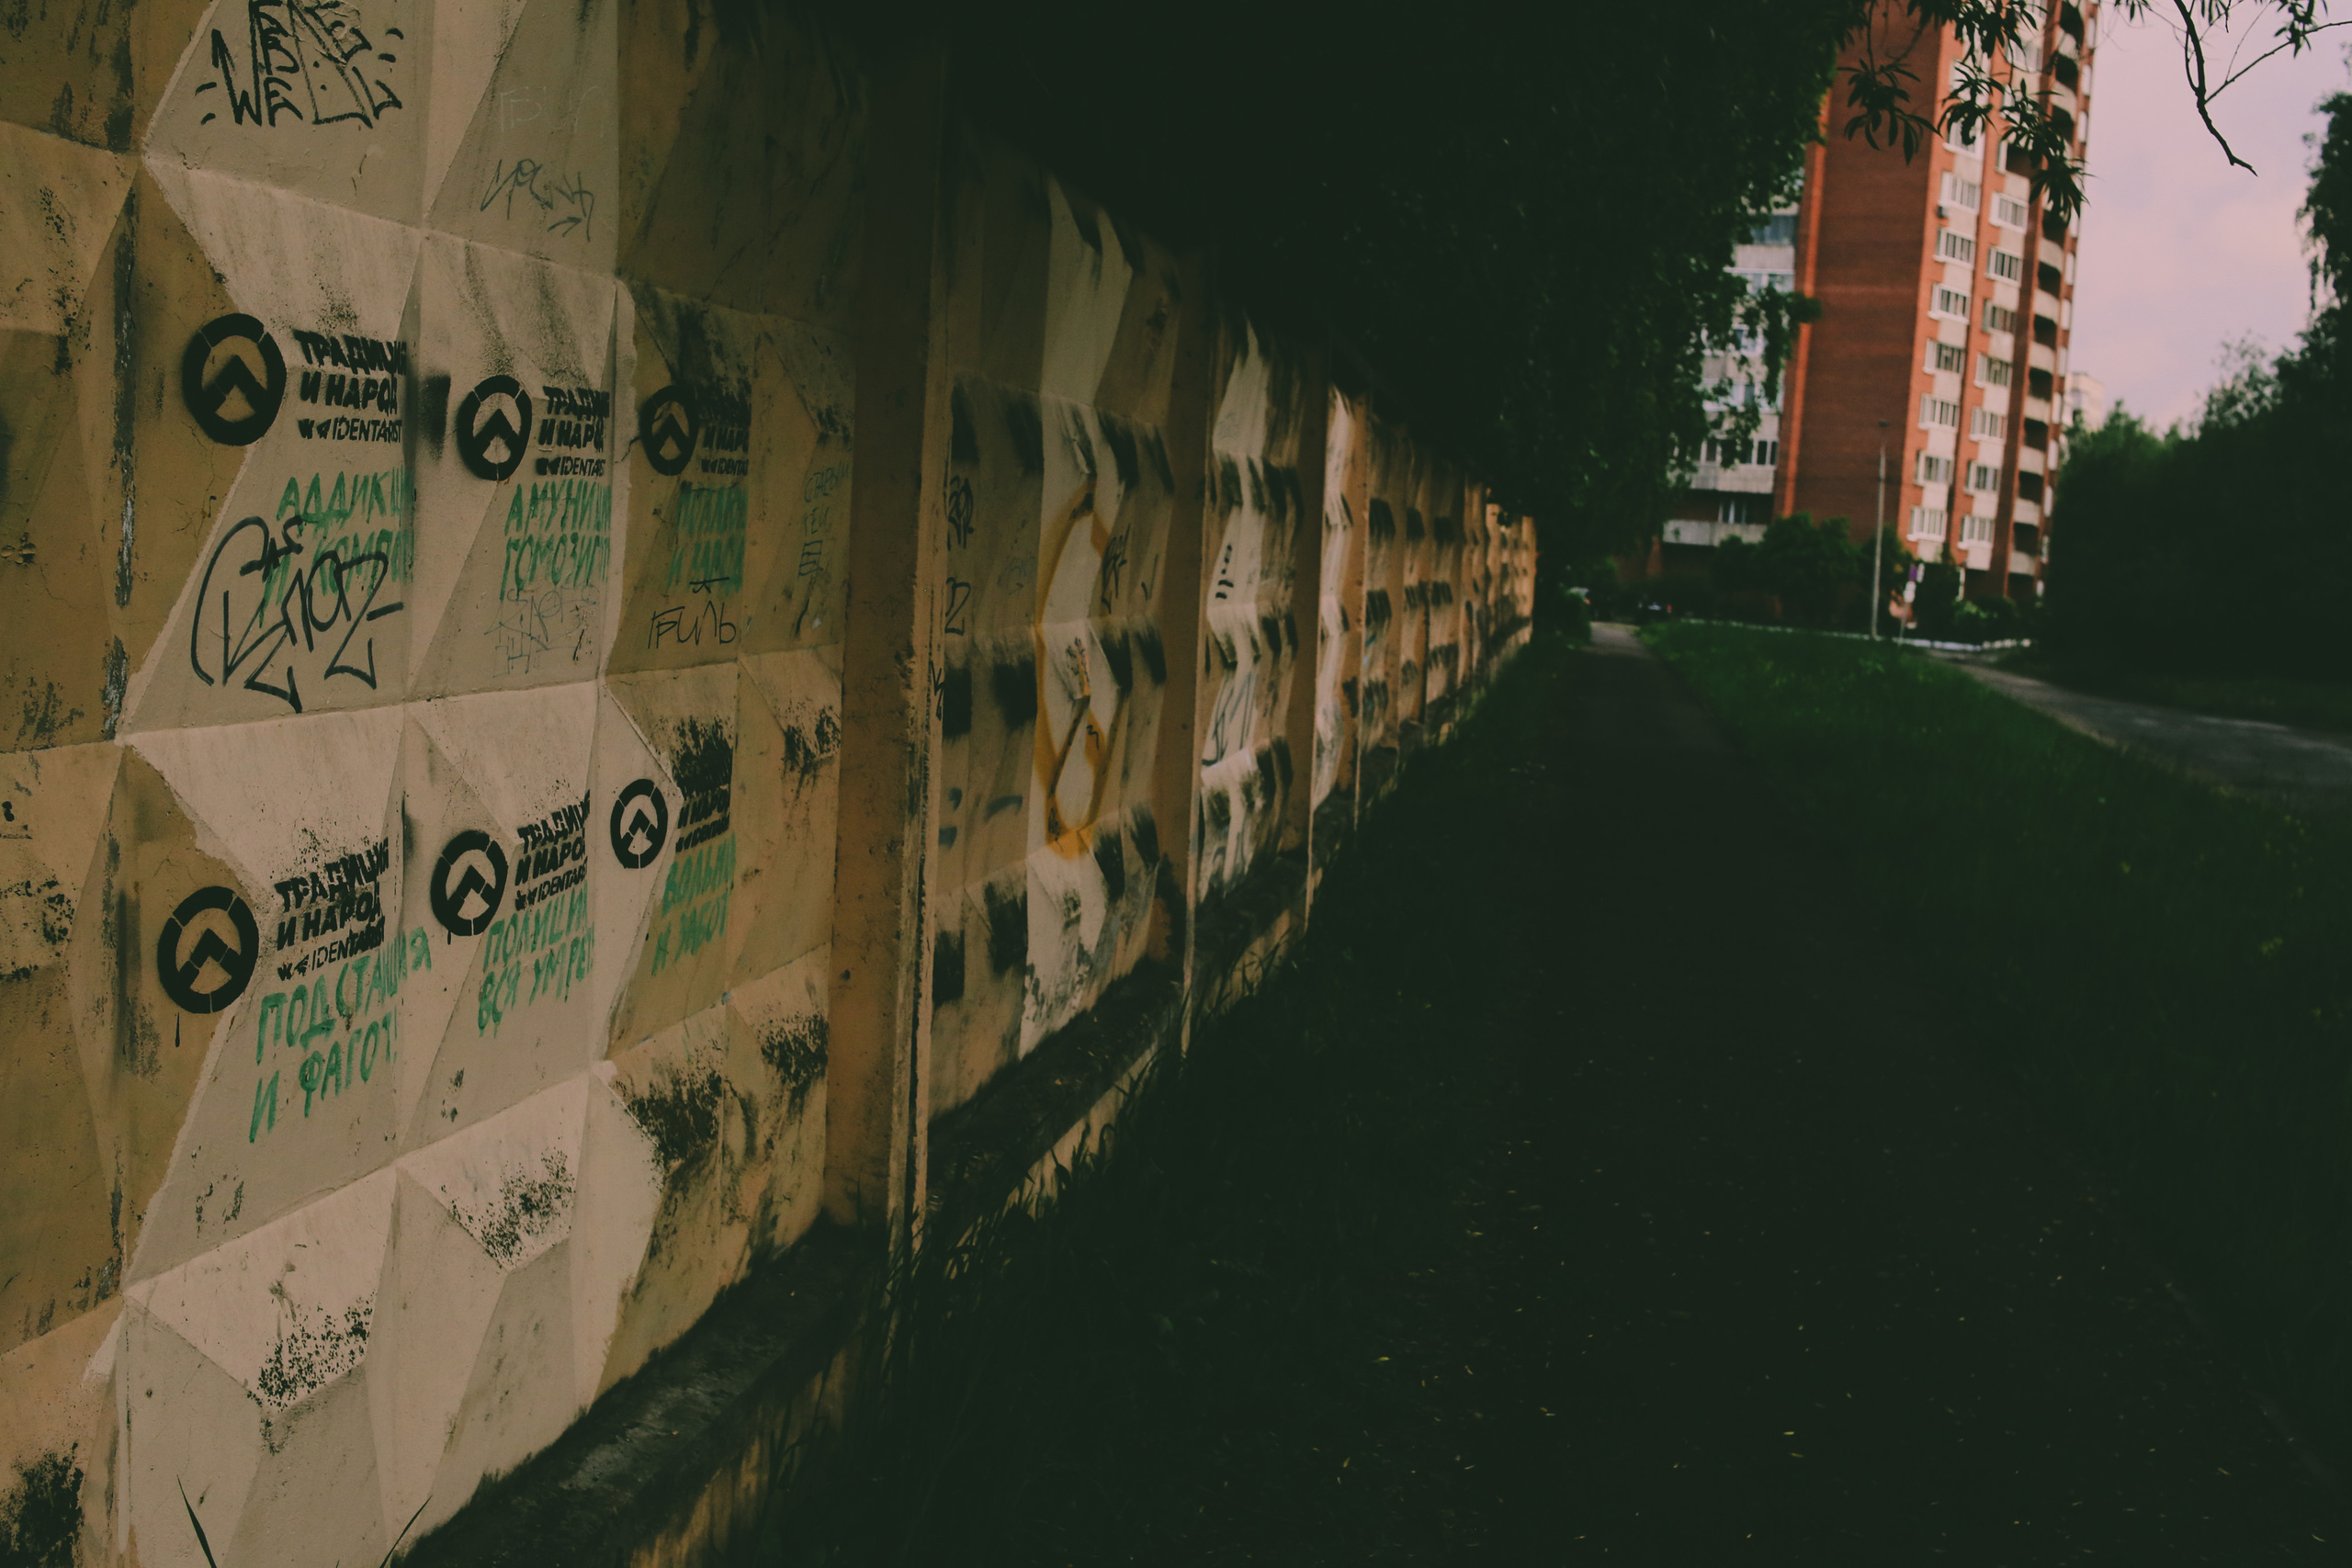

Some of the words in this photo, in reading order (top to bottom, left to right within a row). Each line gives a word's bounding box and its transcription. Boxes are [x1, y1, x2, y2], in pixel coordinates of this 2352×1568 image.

[300, 371, 322, 404] И
[277, 917, 297, 952] И
[249, 1070, 279, 1144] И
